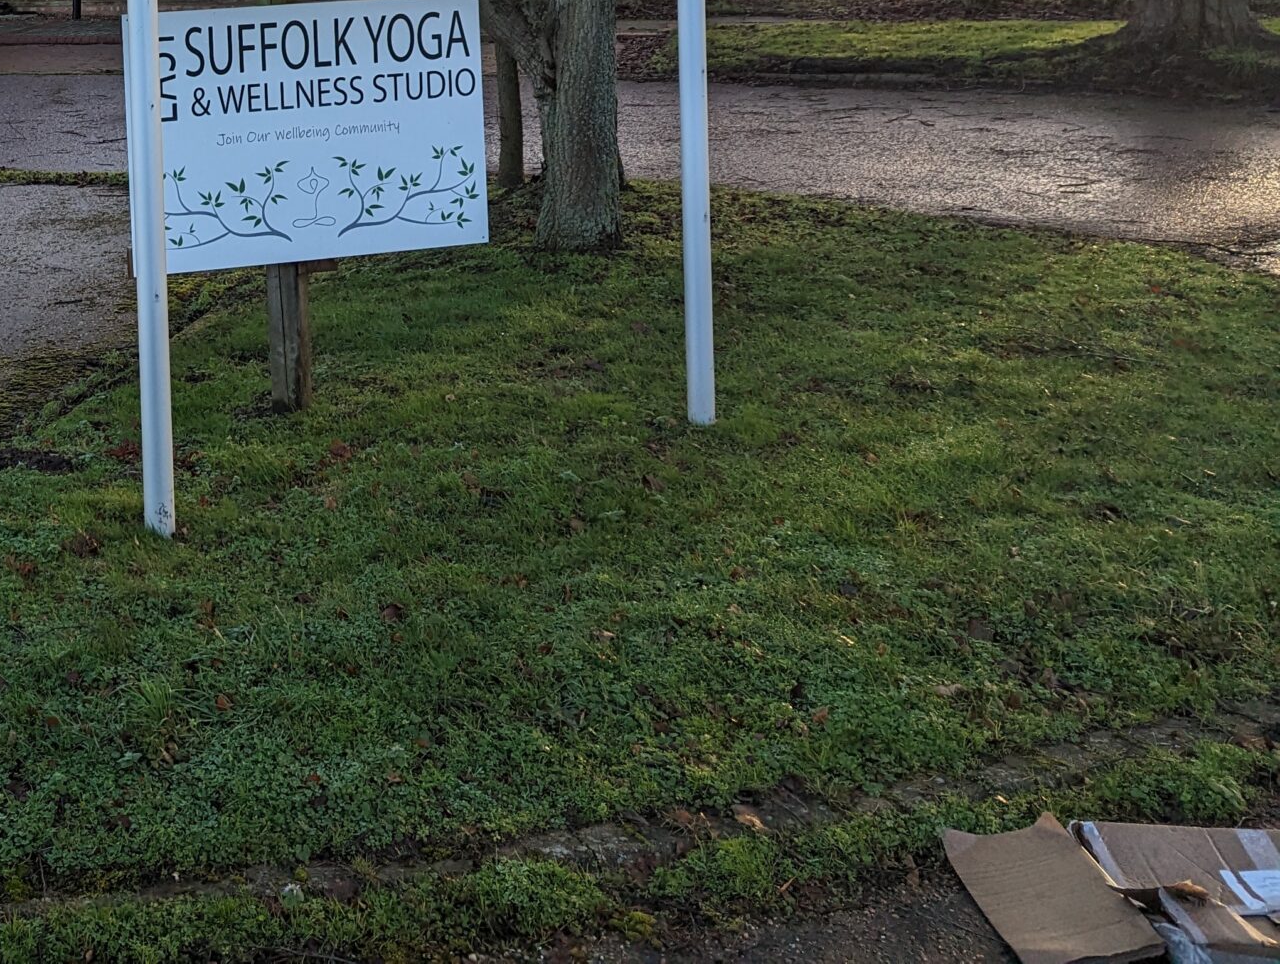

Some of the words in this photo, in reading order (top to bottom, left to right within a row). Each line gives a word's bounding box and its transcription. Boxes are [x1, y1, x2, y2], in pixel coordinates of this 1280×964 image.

[185, 16, 357, 77] SUFFOLK
[363, 9, 470, 64] YOGA
[191, 87, 211, 117] &
[217, 75, 364, 115] WELLNESS
[372, 68, 476, 103] STUDIO
[216, 133, 242, 147] Join
[246, 131, 271, 143] Our
[275, 126, 331, 142] Wellbeing
[335, 119, 400, 137] Community
